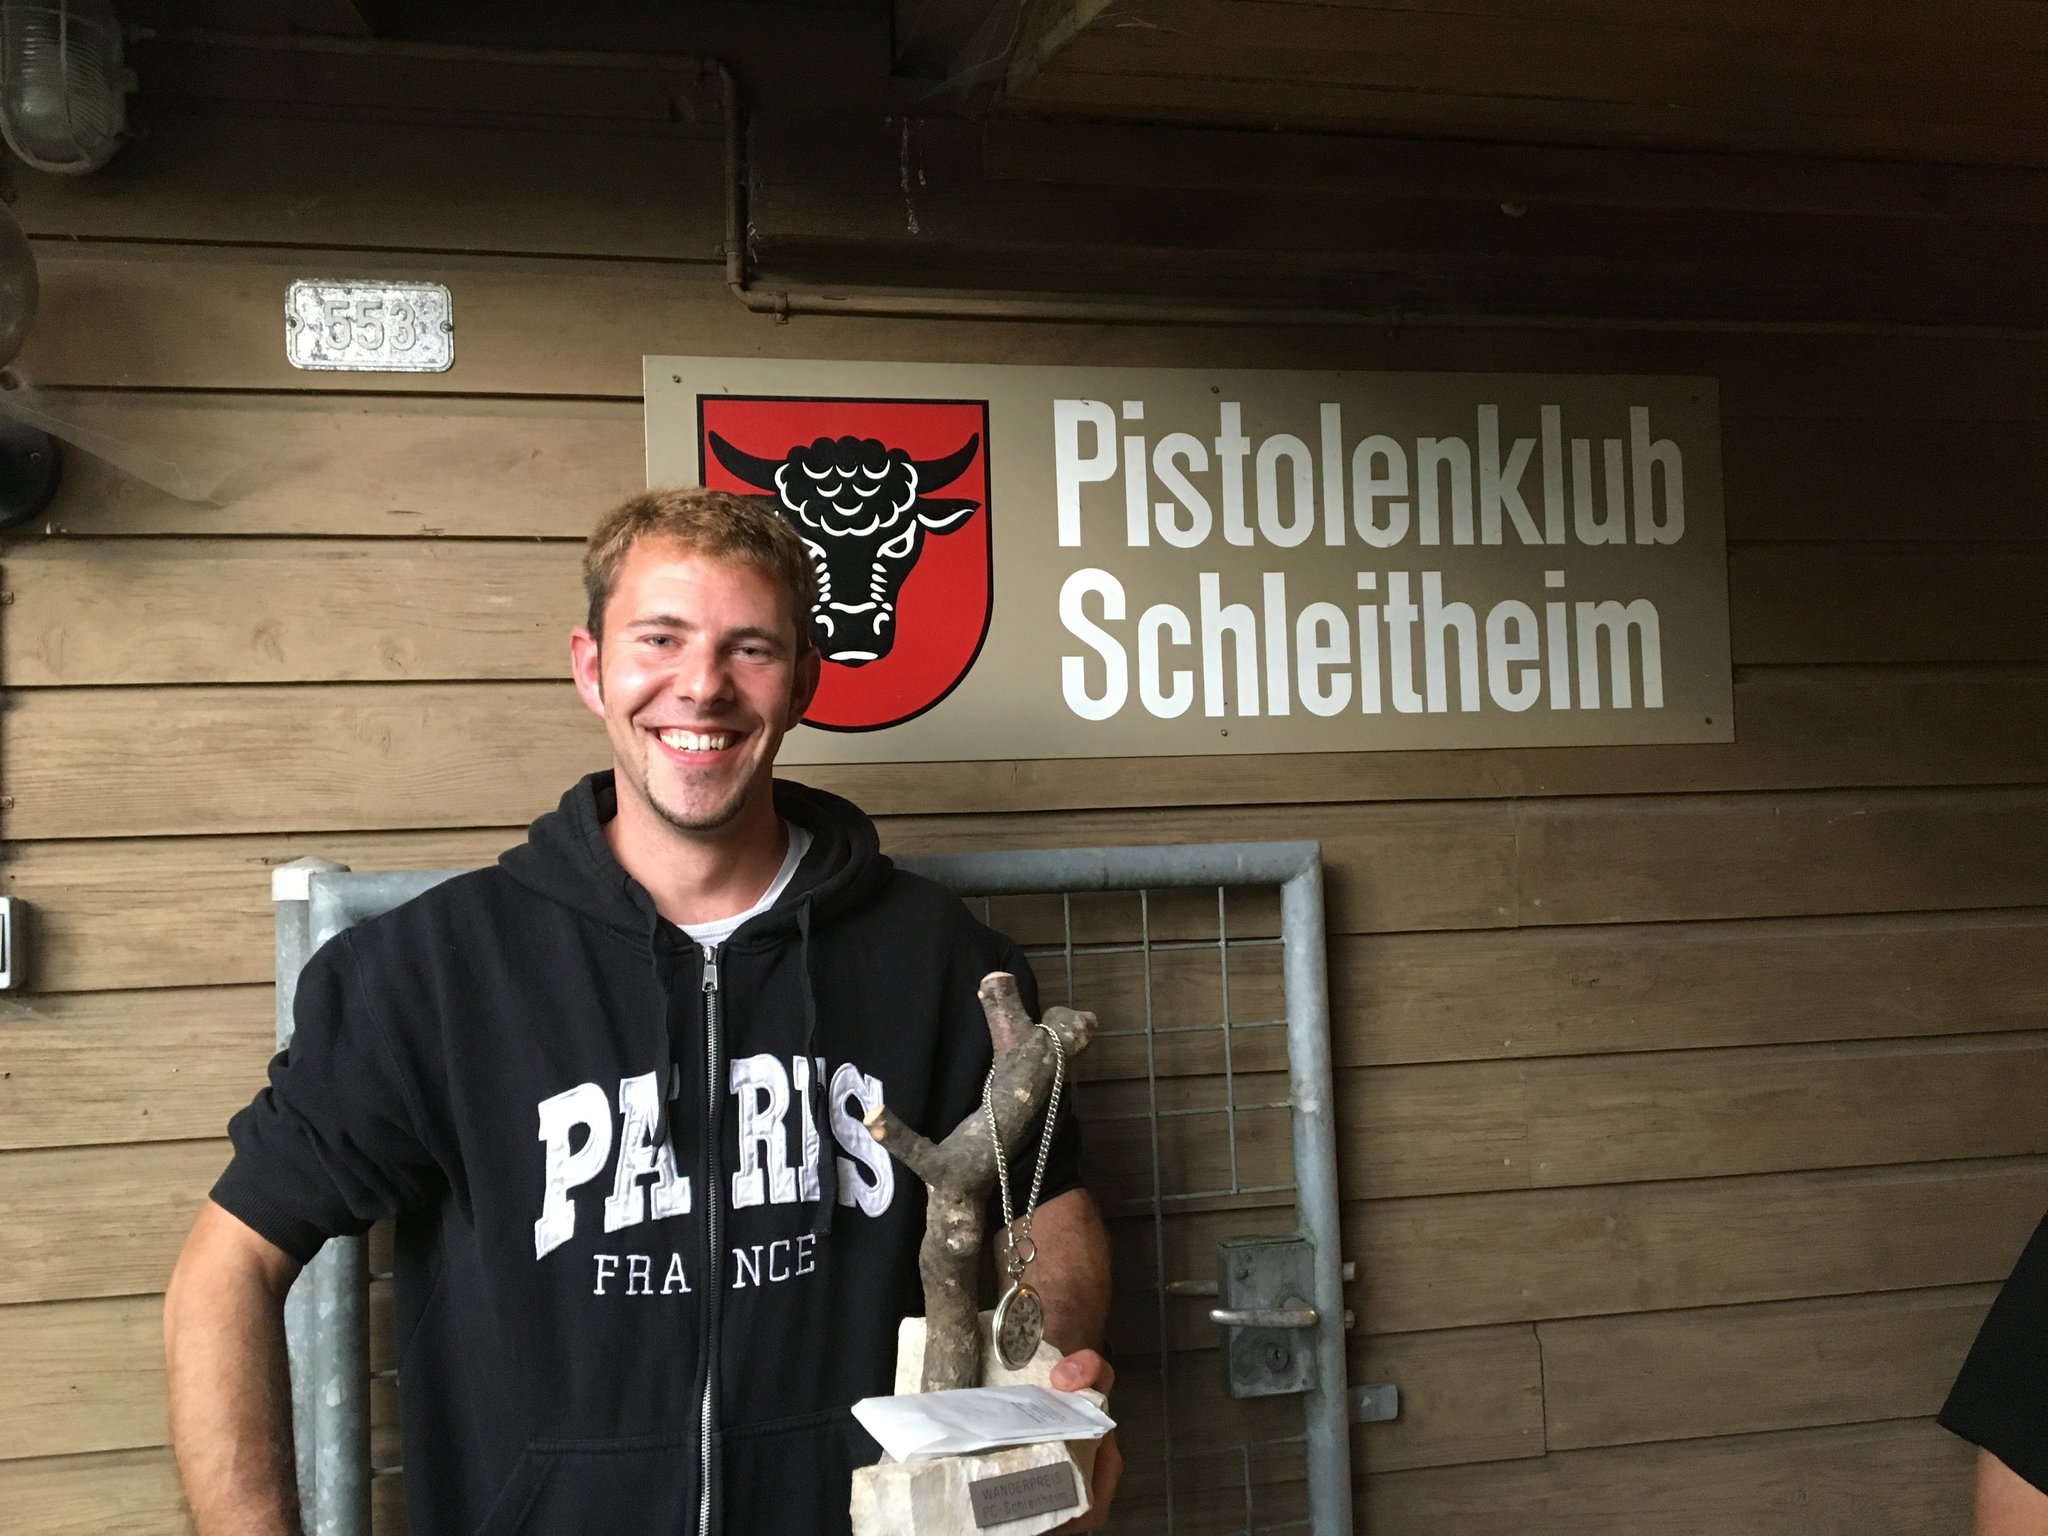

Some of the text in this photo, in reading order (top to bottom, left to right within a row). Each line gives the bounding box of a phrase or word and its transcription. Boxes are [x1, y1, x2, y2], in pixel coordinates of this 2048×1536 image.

[323, 300, 417, 351] 553
[1053, 399, 1686, 549] Pistolenklub
[1058, 567, 1664, 722] Schleitheim
[535, 1053, 895, 1261] PARIS
[593, 1233, 817, 1296] FRANCE
[981, 1471, 1063, 1501] WANDERPREIS
